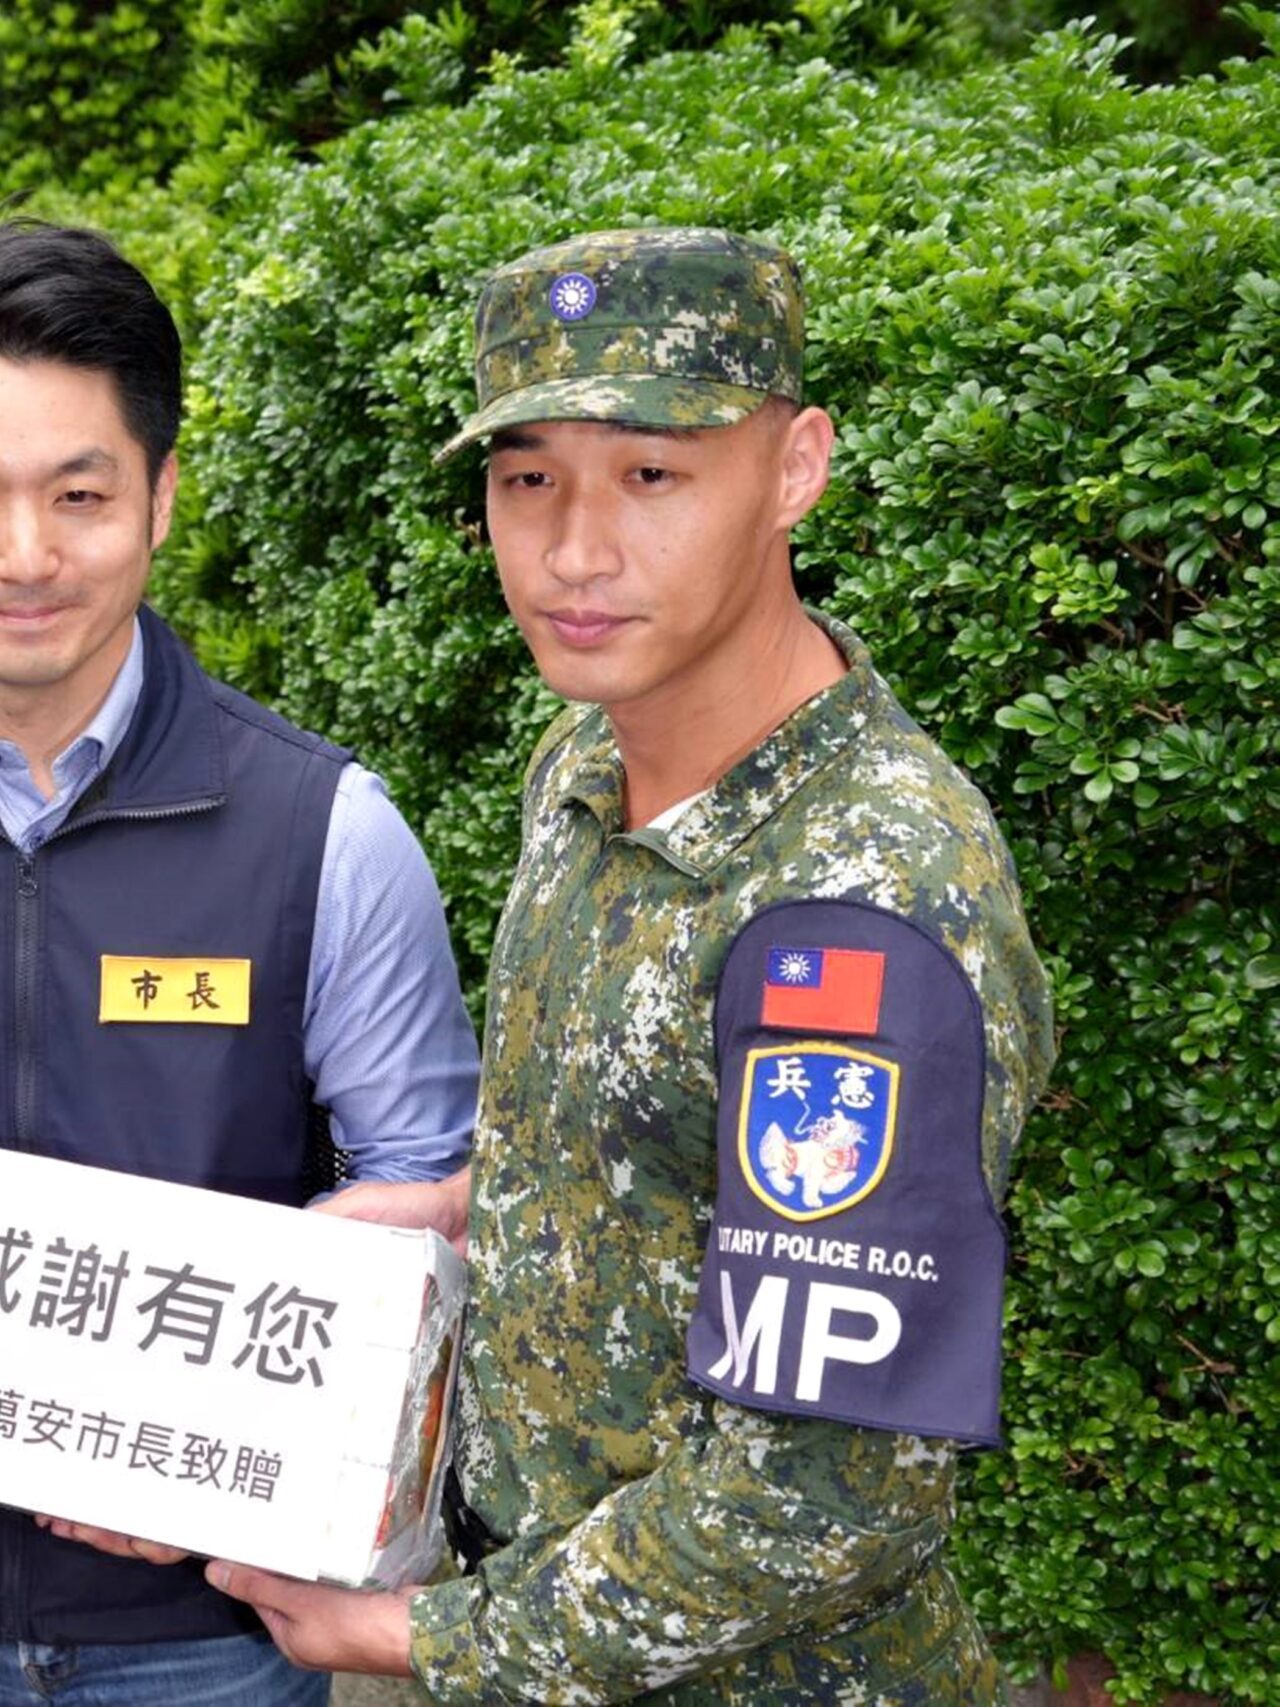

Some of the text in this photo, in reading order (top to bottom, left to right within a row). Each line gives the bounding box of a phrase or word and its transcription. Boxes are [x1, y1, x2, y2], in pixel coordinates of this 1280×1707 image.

[130, 968, 221, 1011] 市長
[773, 1233, 861, 1270] POLICE
[867, 1247, 939, 1282] R.O.C.
[706, 1269, 903, 1403] MP
